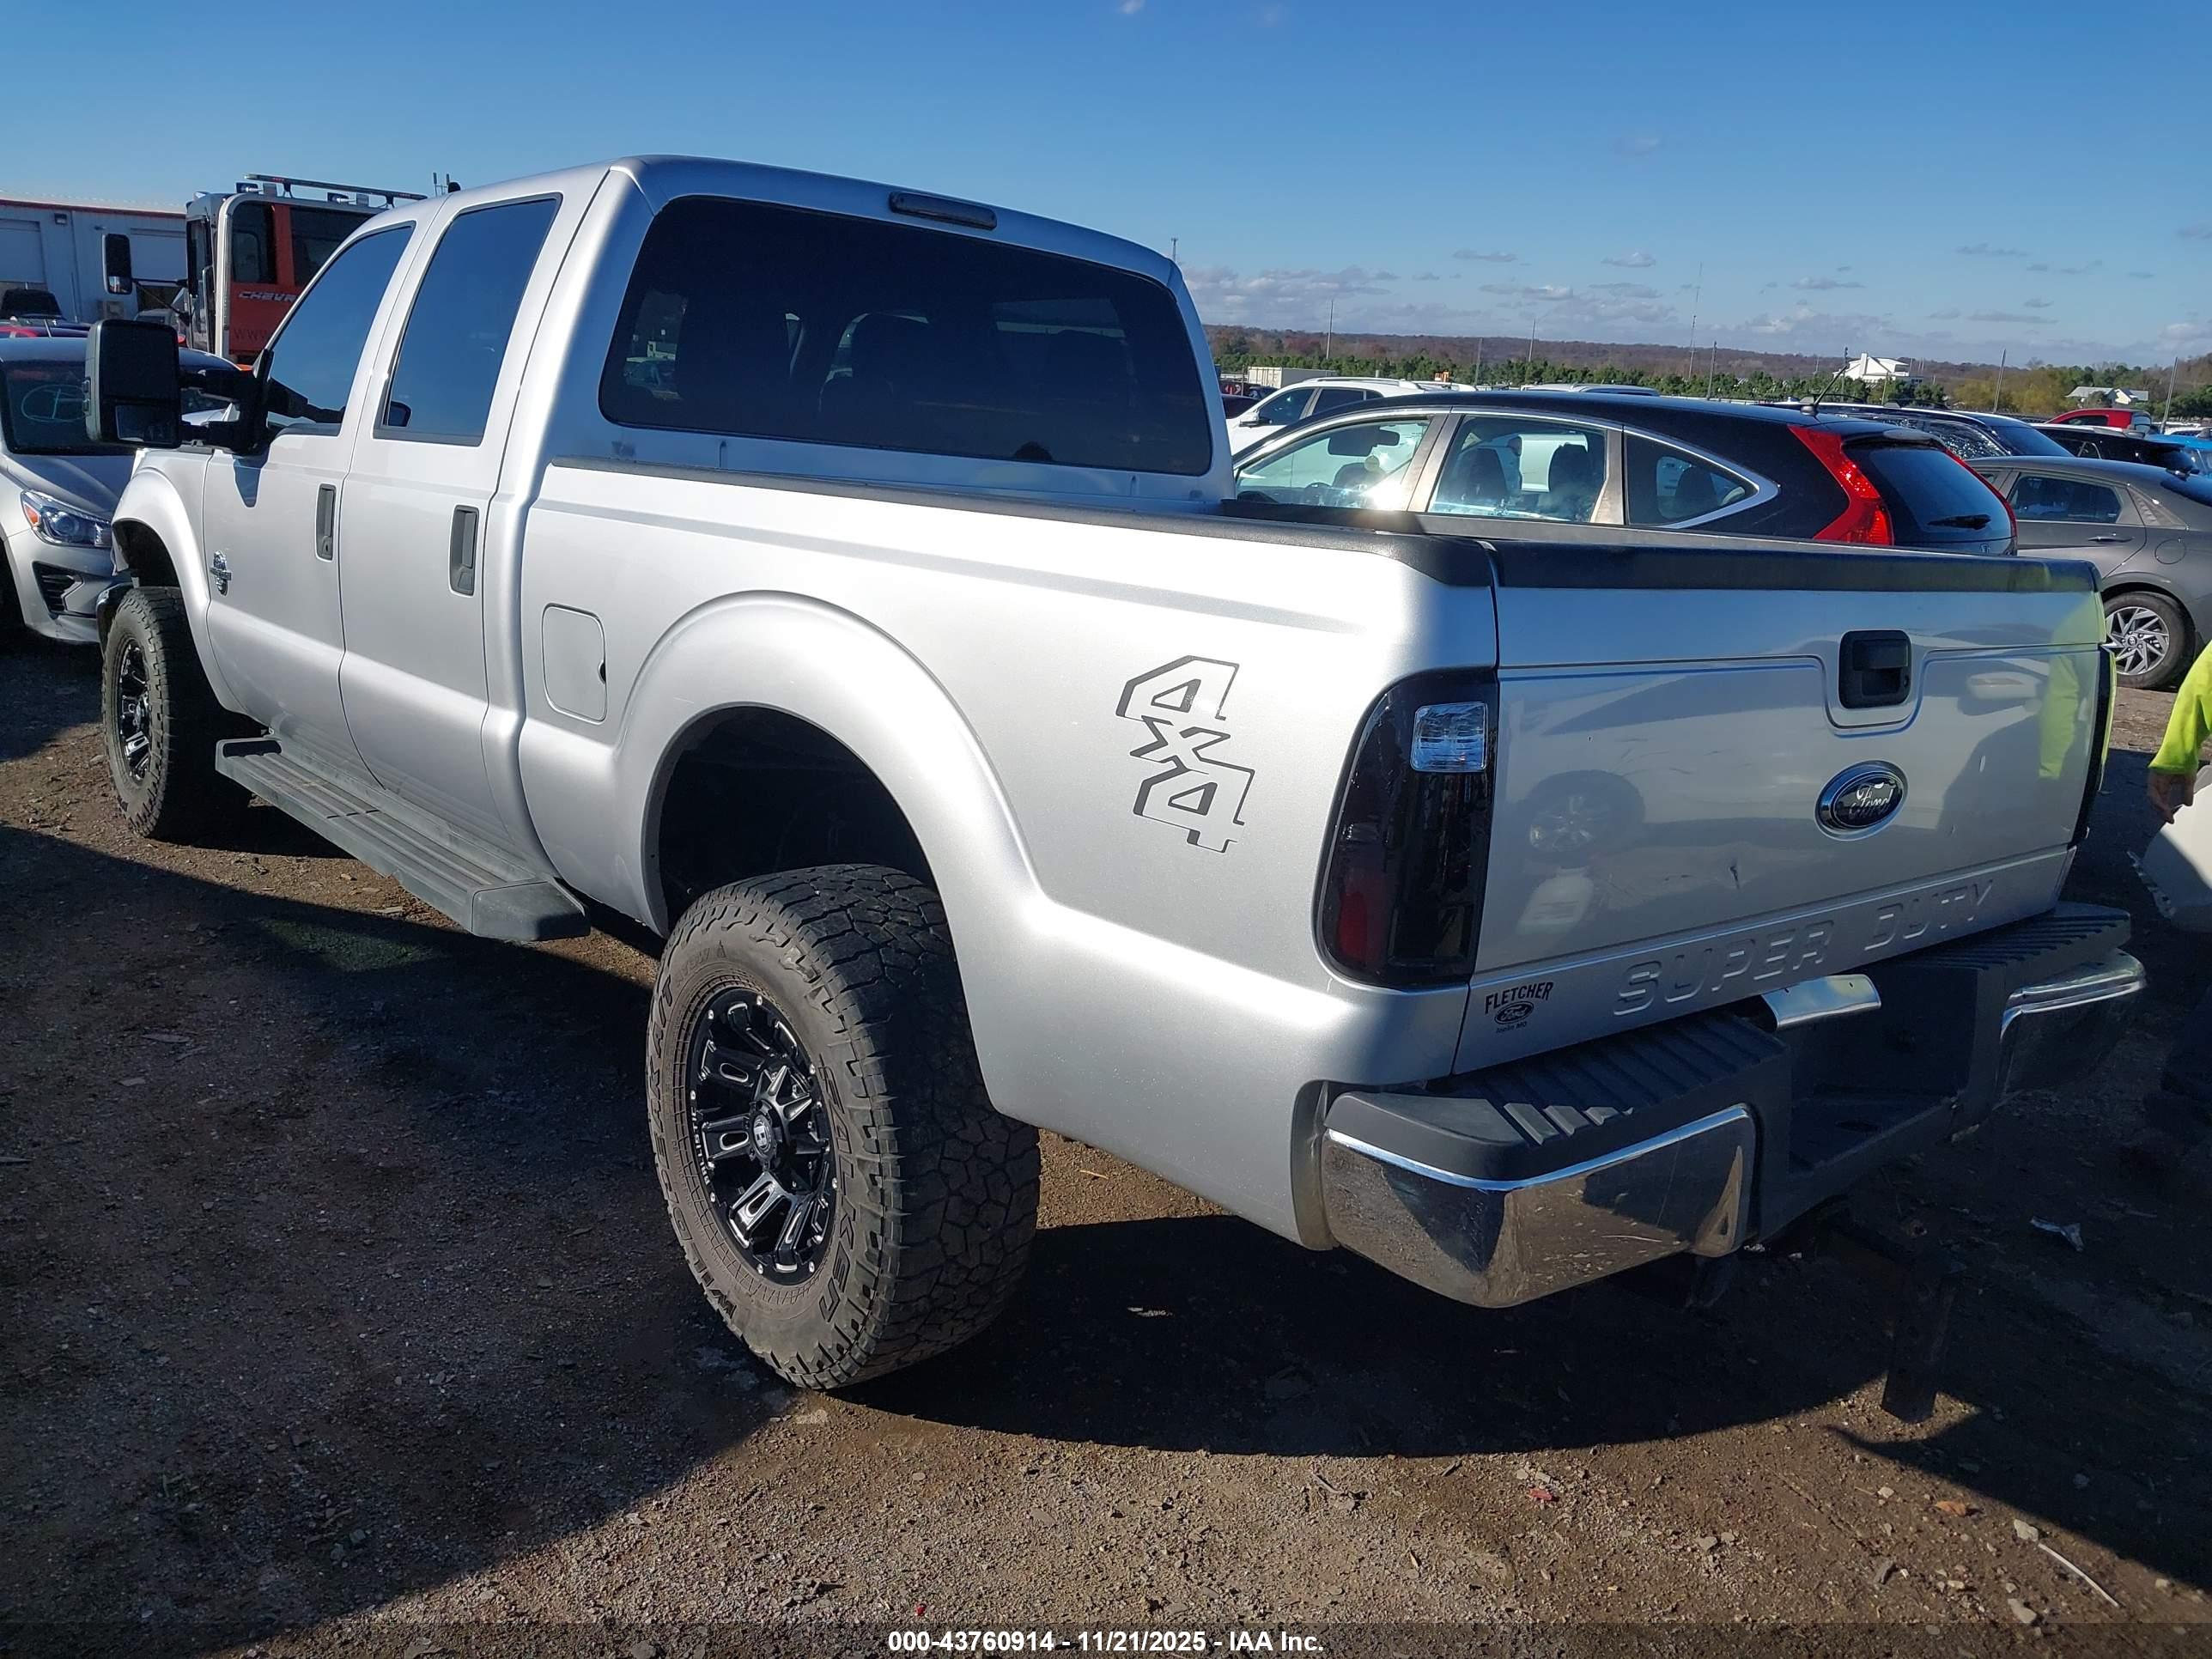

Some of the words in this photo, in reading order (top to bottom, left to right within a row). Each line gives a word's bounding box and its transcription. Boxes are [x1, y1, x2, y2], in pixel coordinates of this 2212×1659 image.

[1485, 982, 1553, 1014] FLETCHER
[1613, 920, 1834, 1016] SUPER
[1864, 879, 1994, 951] DUTY
[690, 1106, 710, 1185] BALLISTIC
[818, 1053, 856, 1322] FALKEN
